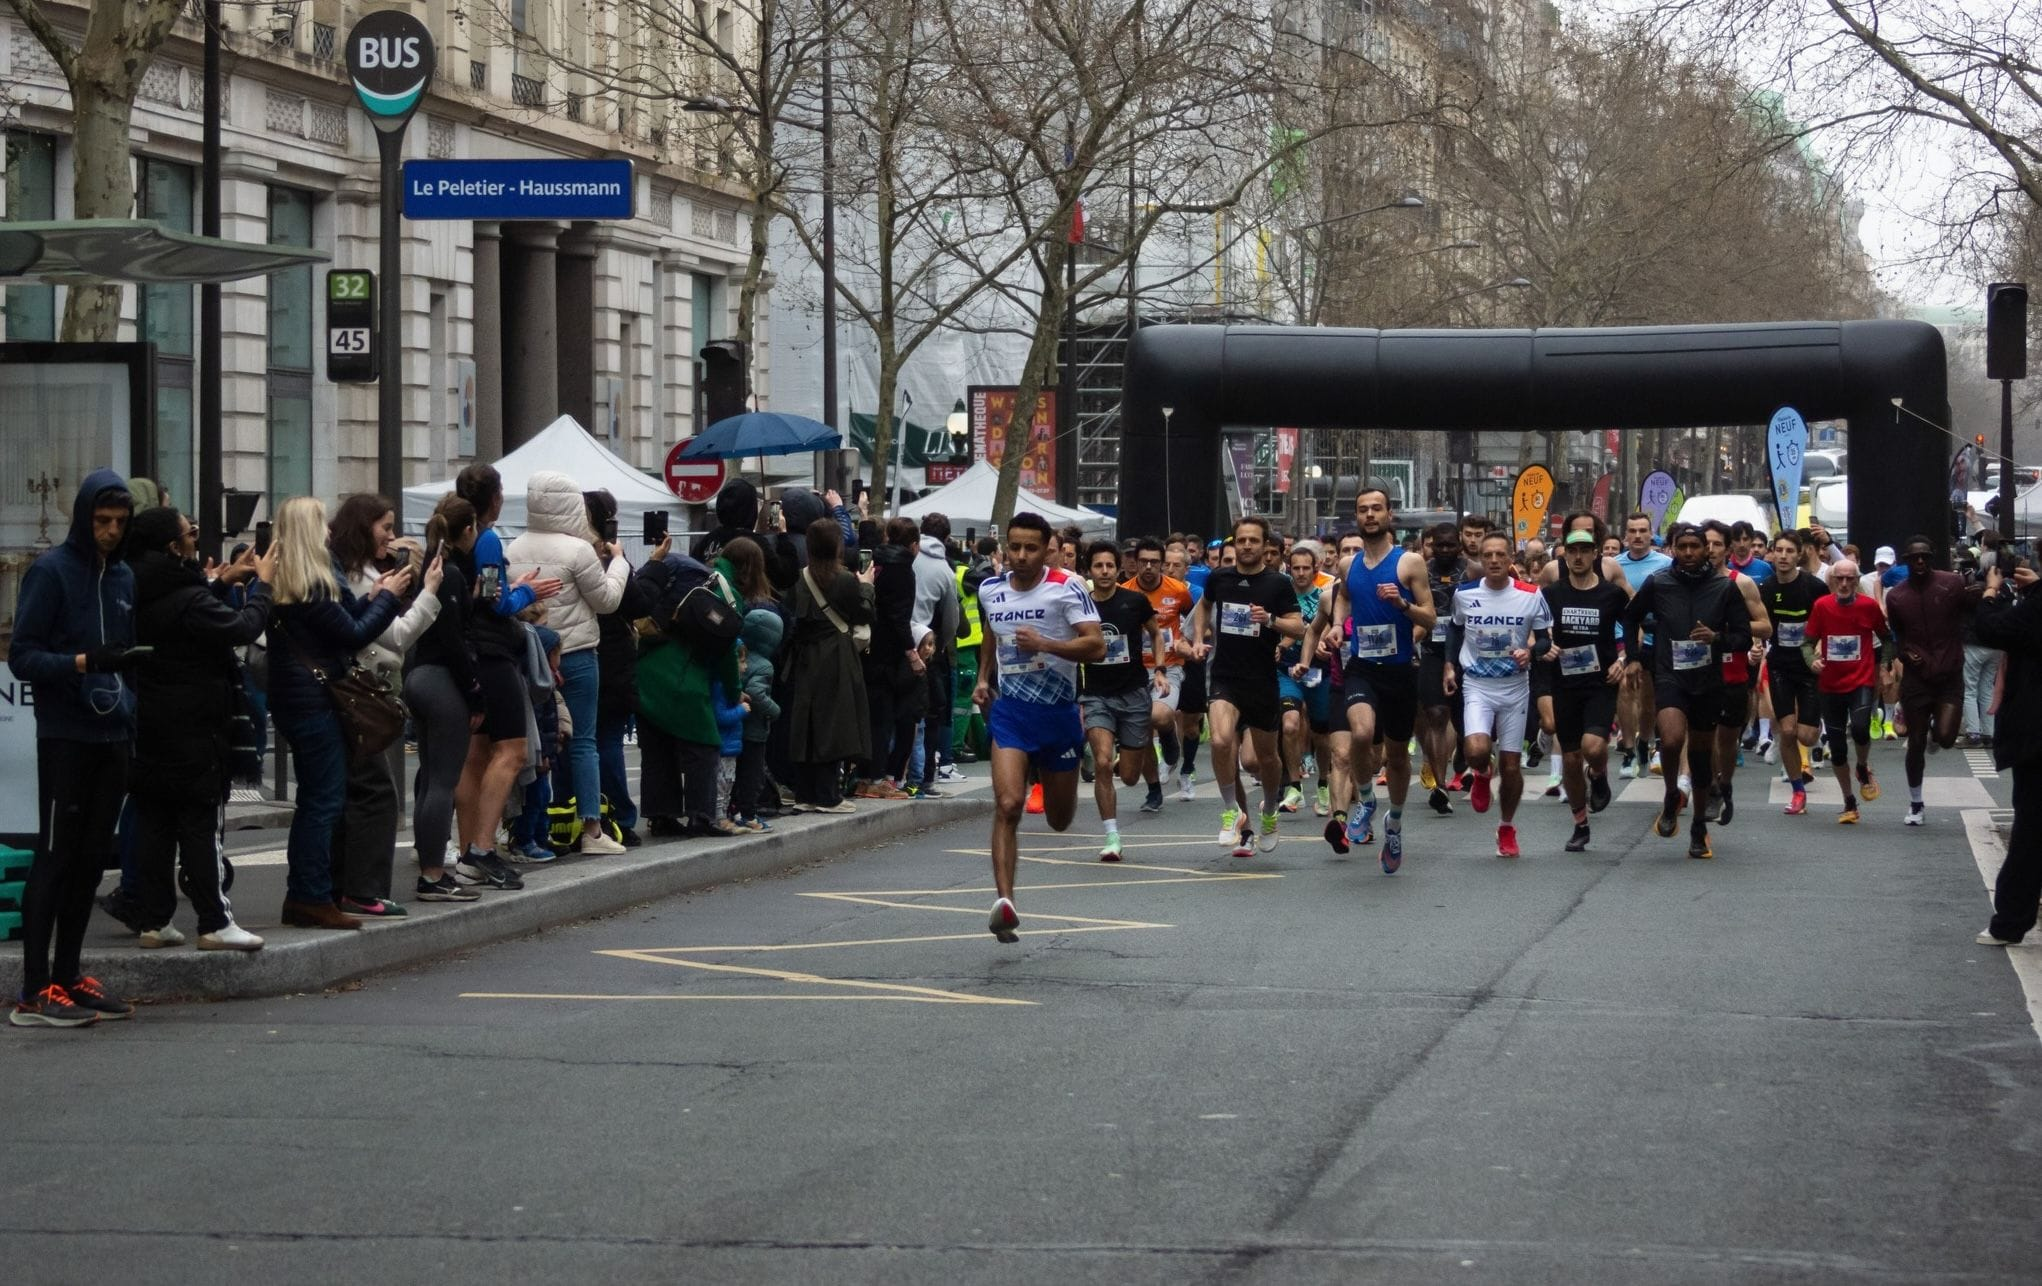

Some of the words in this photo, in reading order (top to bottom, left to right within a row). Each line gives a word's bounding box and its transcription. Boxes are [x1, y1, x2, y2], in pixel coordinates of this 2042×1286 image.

[359, 37, 420, 68] BUS
[413, 180, 434, 196] Le
[438, 179, 506, 196] Peletier
[520, 180, 621, 196] Haussmann
[335, 275, 365, 297] 32
[335, 330, 365, 351] 45
[1775, 418, 1796, 435] NEUF
[1523, 475, 1545, 486] NEUF
[989, 608, 1046, 622] FRANCE
[1467, 615, 1525, 626] FRANCE
[1561, 615, 1600, 626] BACKYARD
